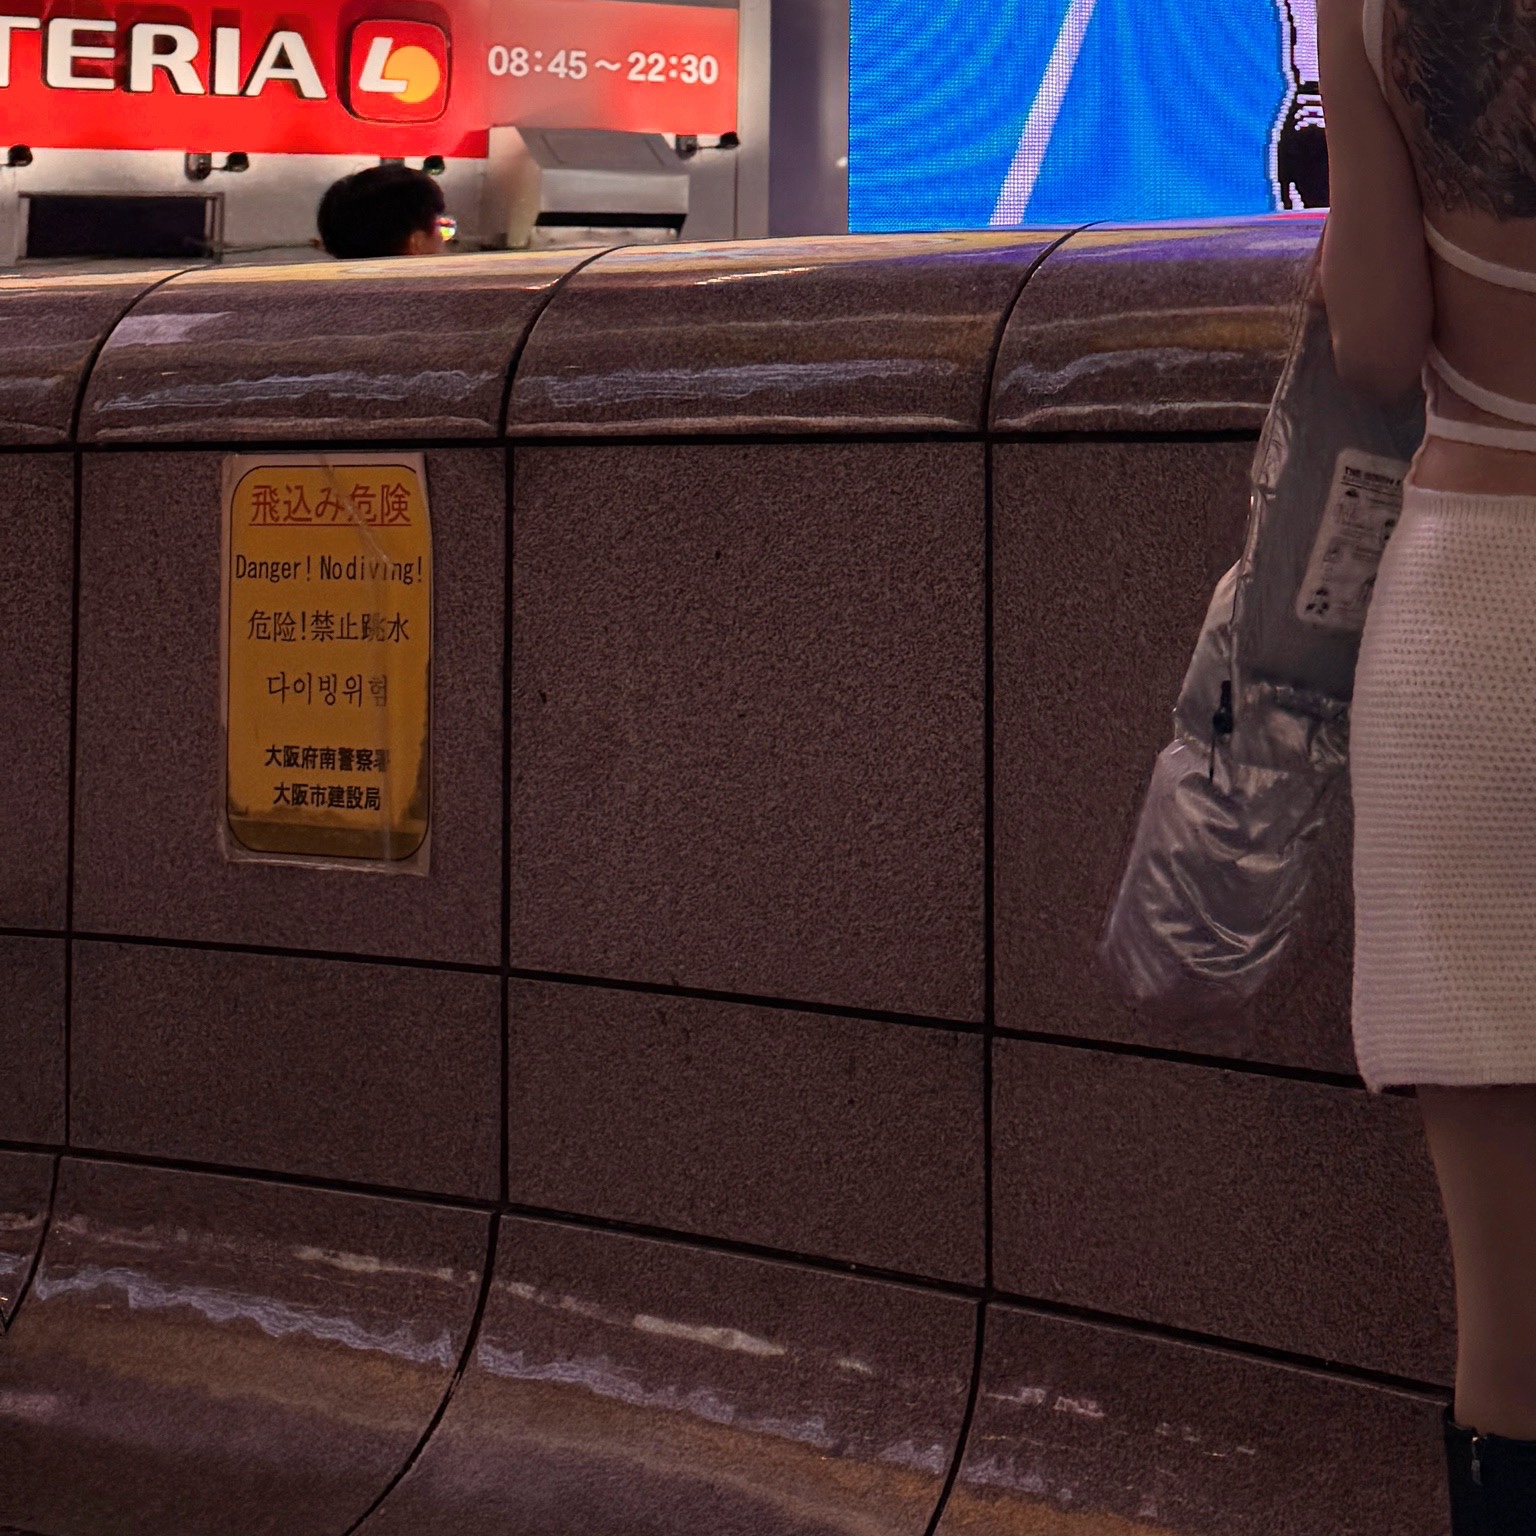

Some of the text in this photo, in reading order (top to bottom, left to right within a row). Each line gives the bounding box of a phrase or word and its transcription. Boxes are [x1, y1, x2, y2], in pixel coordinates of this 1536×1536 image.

[251, 482, 411, 525] 飛込み危険
[235, 554, 311, 583] Danger!
[266, 670, 389, 710] 다이빙위험
[264, 743, 391, 774] 大阪府南警察署
[272, 781, 382, 812] 大阪市建設局
